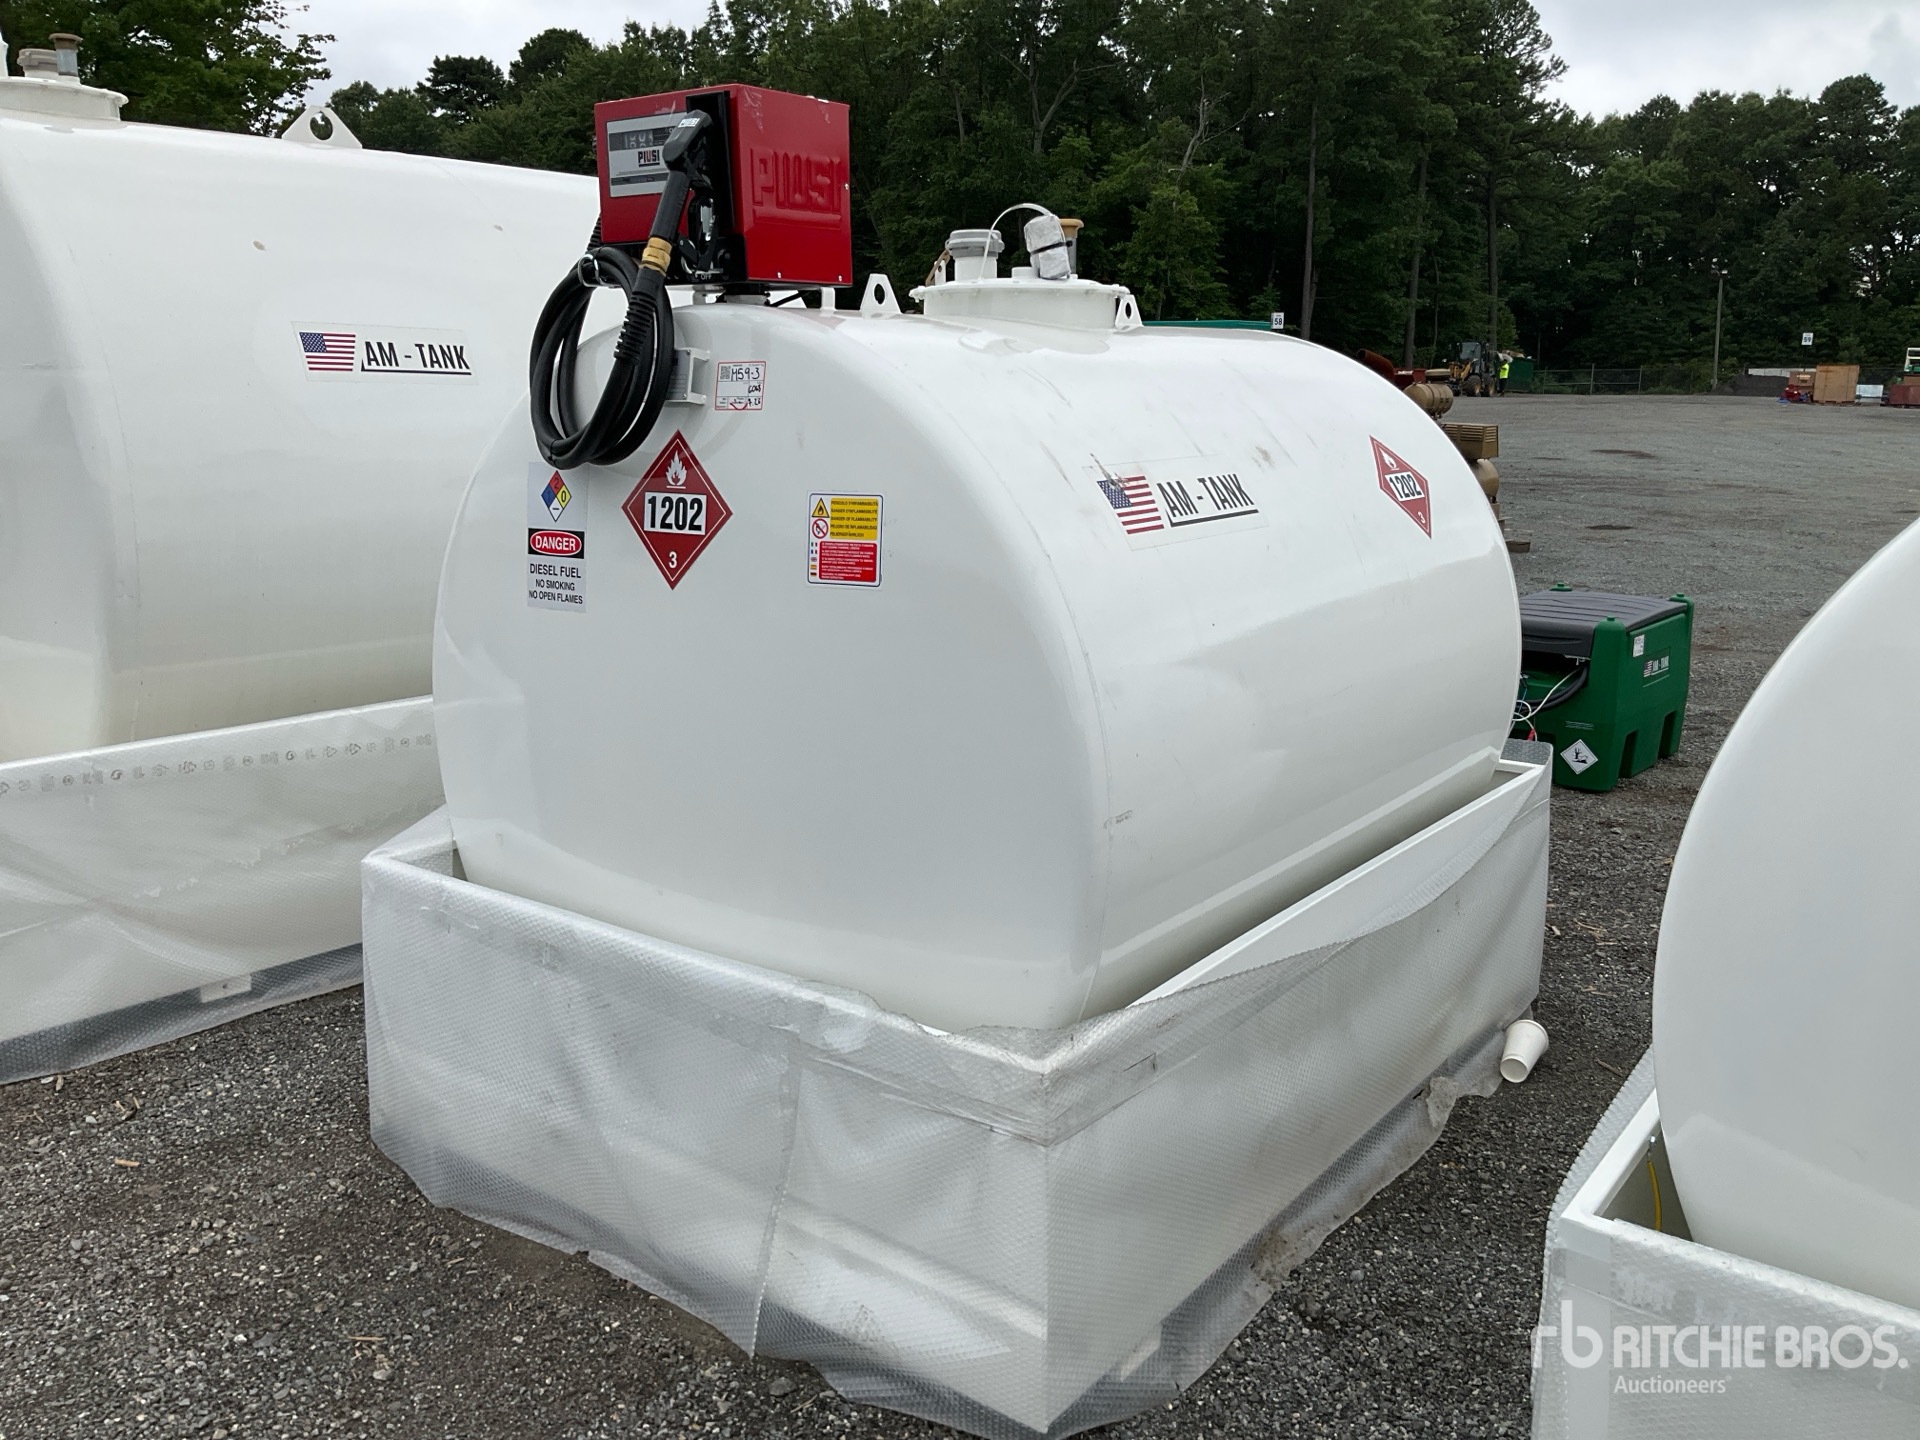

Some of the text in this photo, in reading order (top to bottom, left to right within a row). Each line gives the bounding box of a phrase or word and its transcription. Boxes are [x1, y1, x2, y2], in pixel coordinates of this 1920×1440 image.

[637, 149, 660, 164] PIUSI
[751, 147, 841, 213] PIUSI
[1274, 318, 1283, 326] 58
[364, 341, 399, 367] AM
[414, 343, 471, 370] TANK
[1389, 473, 1423, 499] 1202
[1156, 480, 1199, 517] AM
[1197, 473, 1254, 511] TANK
[647, 495, 703, 531] 1202
[535, 535, 576, 551] DANGER
[668, 551, 678, 569] 3
[529, 563, 582, 578] DIESEL FUEL
[535, 579, 575, 591] NO SMOKING
[529, 590, 583, 604] NO OPEN FLAMES
